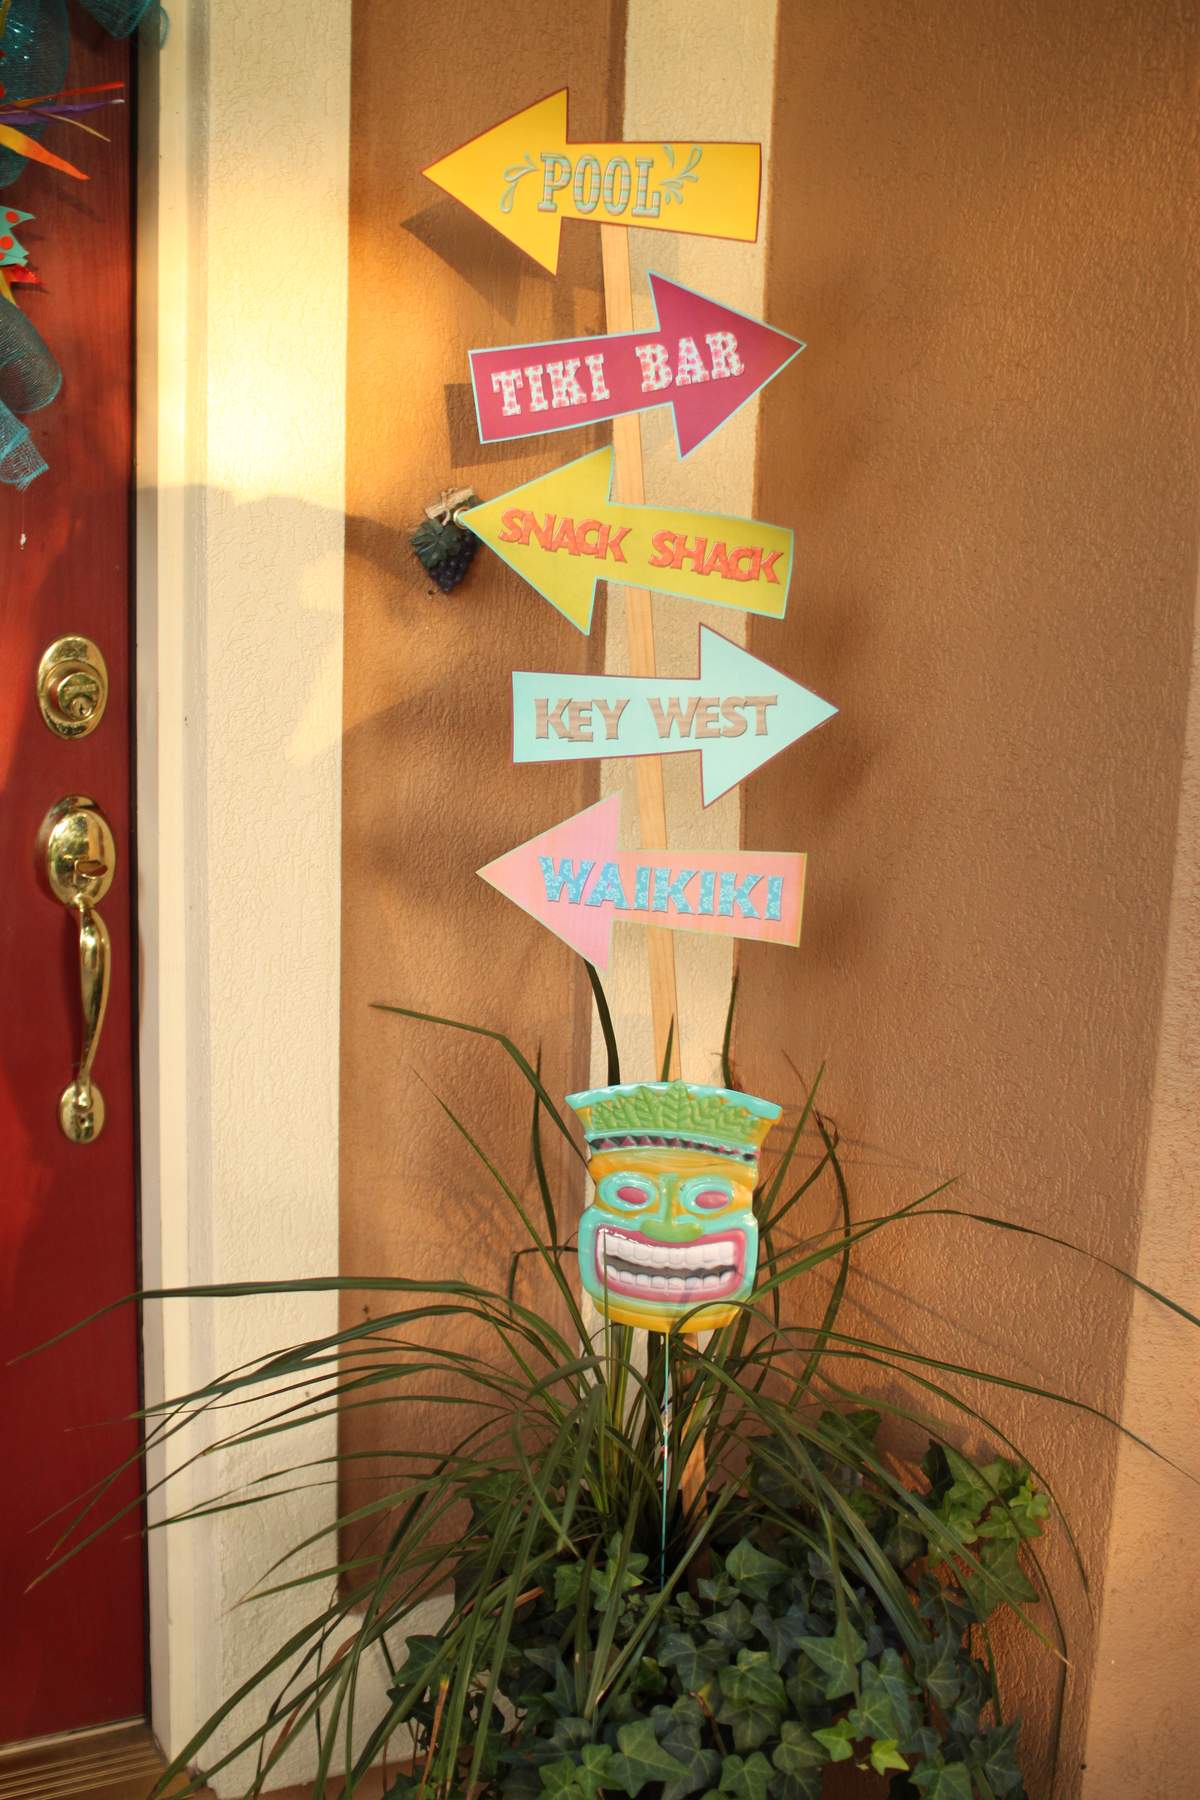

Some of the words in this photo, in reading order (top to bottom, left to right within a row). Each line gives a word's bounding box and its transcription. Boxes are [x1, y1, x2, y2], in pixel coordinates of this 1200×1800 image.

[537, 152, 661, 218] POOL
[491, 353, 610, 416] TIKI
[635, 331, 744, 392] BAR
[498, 507, 632, 563] SNACK
[649, 529, 784, 584] SHACK
[534, 697, 630, 742] KEY
[646, 695, 777, 740] WEST
[537, 856, 785, 921] WAIKIKI
